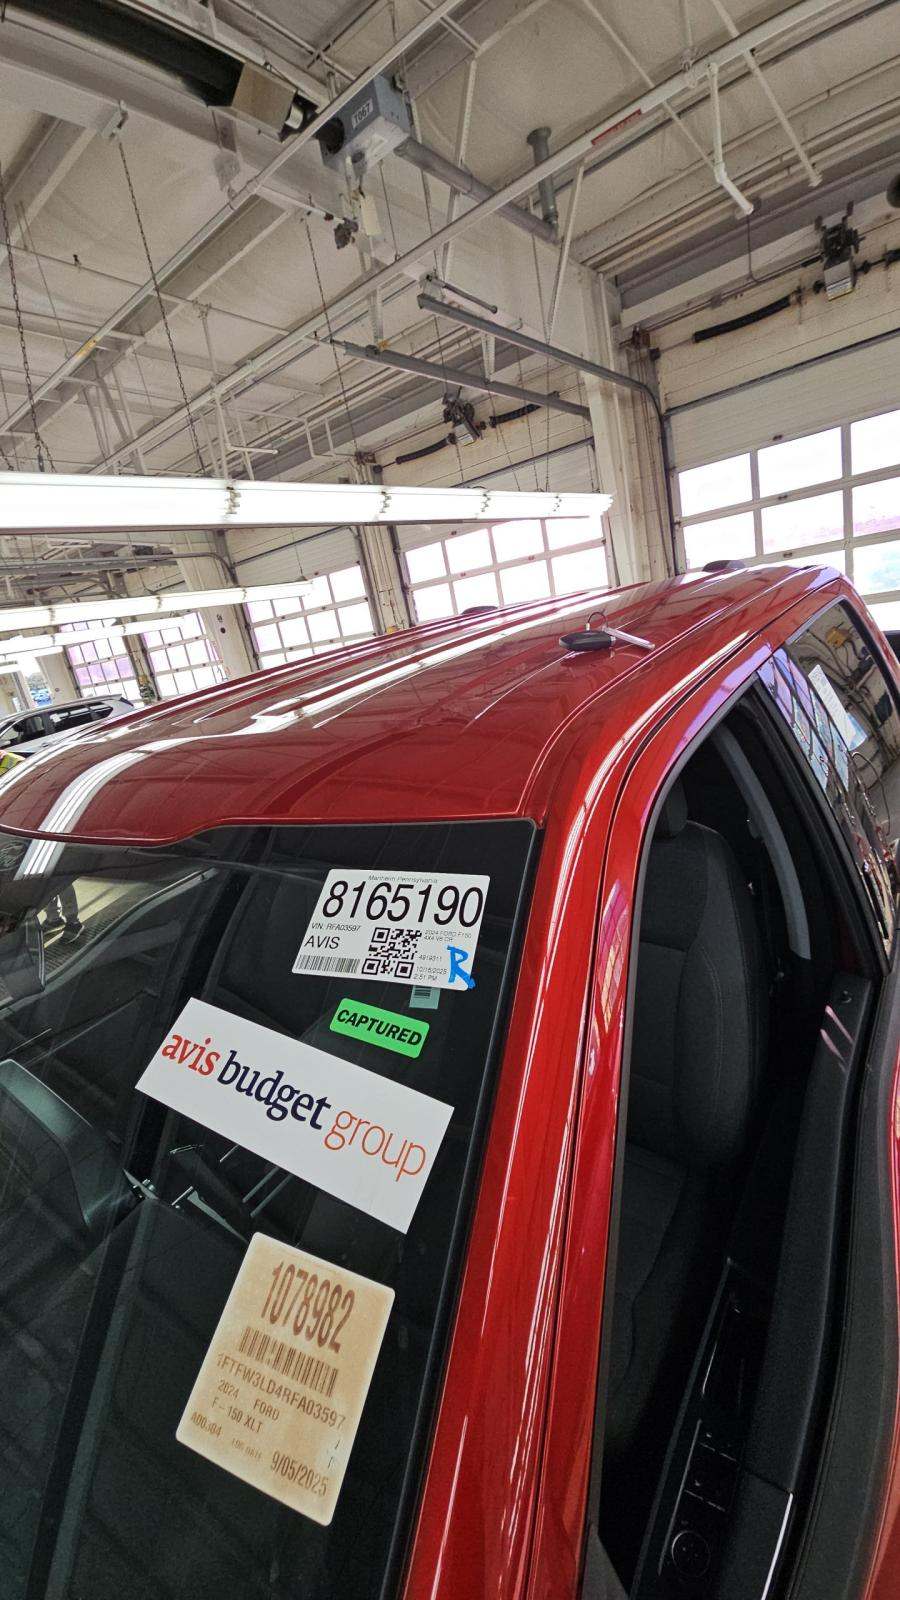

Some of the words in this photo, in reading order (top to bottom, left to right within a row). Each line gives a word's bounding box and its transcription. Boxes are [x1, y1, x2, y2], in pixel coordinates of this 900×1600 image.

[322, 880, 484, 928] 8165190
[304, 935, 340, 950] AVIS
[446, 945, 476, 990] R
[337, 1009, 422, 1045] CAPTURED
[161, 1034, 221, 1076] avis
[217, 1050, 331, 1130] budget
[324, 1110, 426, 1182] group
[260, 1260, 355, 1353] 1078982
[218, 1379, 240, 1400] 2024
[253, 1398, 280, 1421] FORD
[243, 1414, 263, 1433] XLT
[270, 1449, 328, 1497] 9/05/2025
